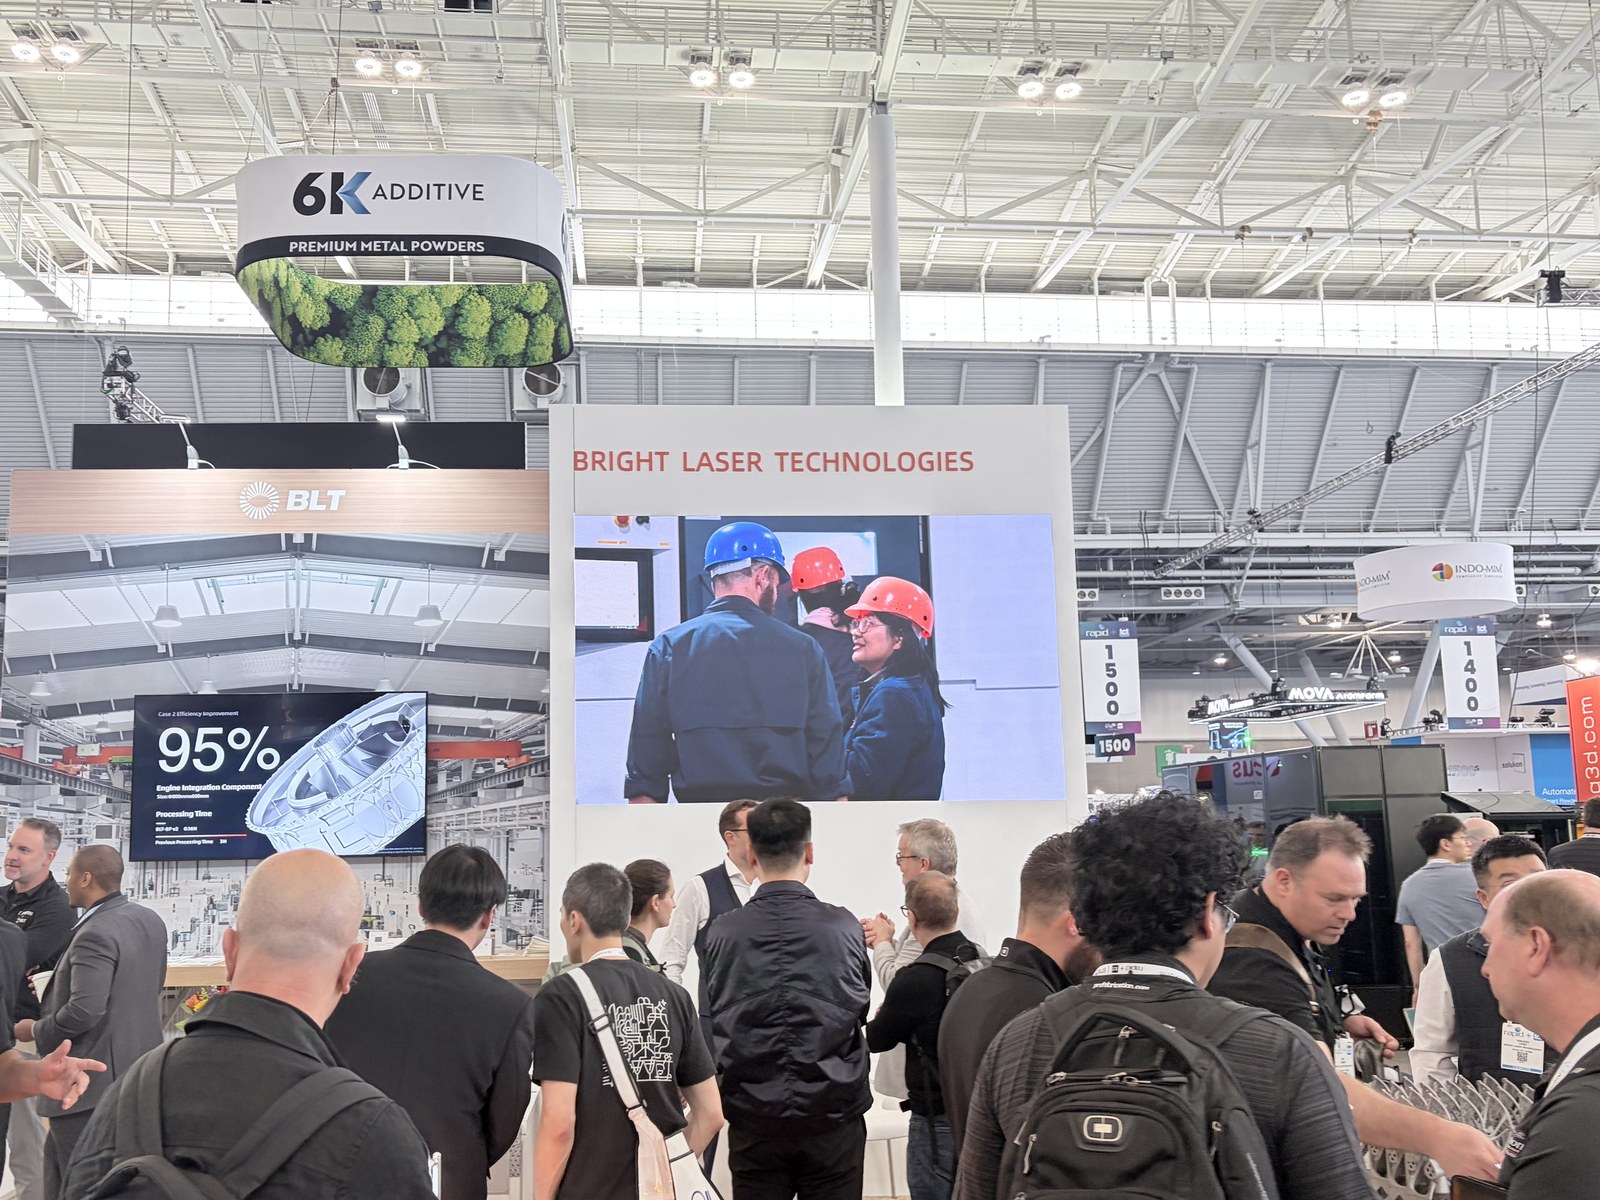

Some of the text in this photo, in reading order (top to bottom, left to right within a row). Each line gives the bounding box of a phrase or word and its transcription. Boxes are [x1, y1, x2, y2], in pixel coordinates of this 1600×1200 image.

[293, 172, 485, 216] 6K ADDITIVE
[289, 240, 485, 253] PREMIUM METAL POWDERS
[573, 450, 975, 473] BRIGHT LASER TECHNOLOGIES
[286, 489, 346, 511] BLT
[1455, 563, 1503, 574] INDO-MIM
[1086, 628, 1109, 638] rapid
[1444, 625, 1467, 634] rapid
[1104, 644, 1120, 716] 1500
[1463, 640, 1479, 712] 1400
[1288, 687, 1334, 700] MOVA
[158, 726, 280, 773] 95%
[1098, 737, 1131, 753] 1500
[1502, 761, 1523, 769] solukon
[156, 783, 263, 793] Engine Integration Component
[155, 810, 194, 819] Processing
